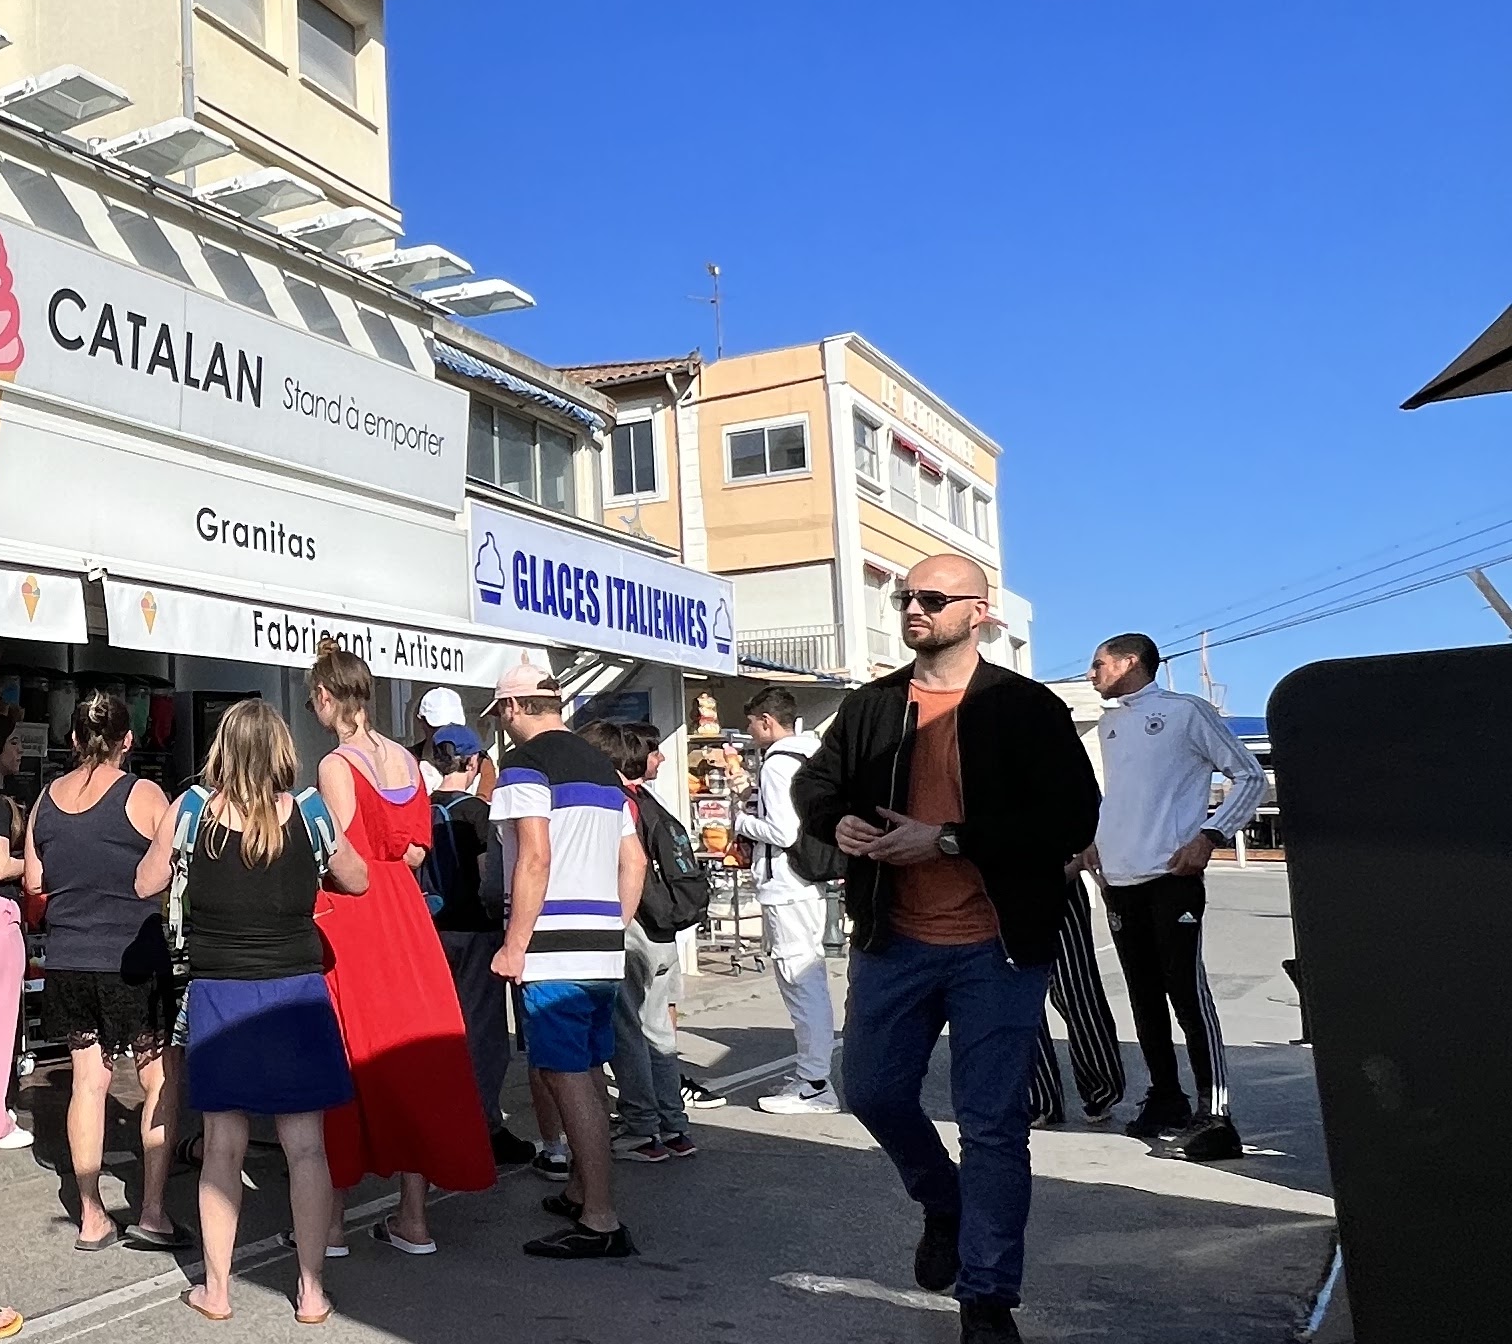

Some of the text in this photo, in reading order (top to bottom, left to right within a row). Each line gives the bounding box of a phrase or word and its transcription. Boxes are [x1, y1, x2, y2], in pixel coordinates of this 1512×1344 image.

[48, 288, 263, 409] CATALAN
[282, 377, 446, 458] Stand à emporter
[196, 507, 316, 561] Granitas
[512, 550, 708, 650] GLACES ITALIENNES
[394, 632, 464, 673] Artisan
